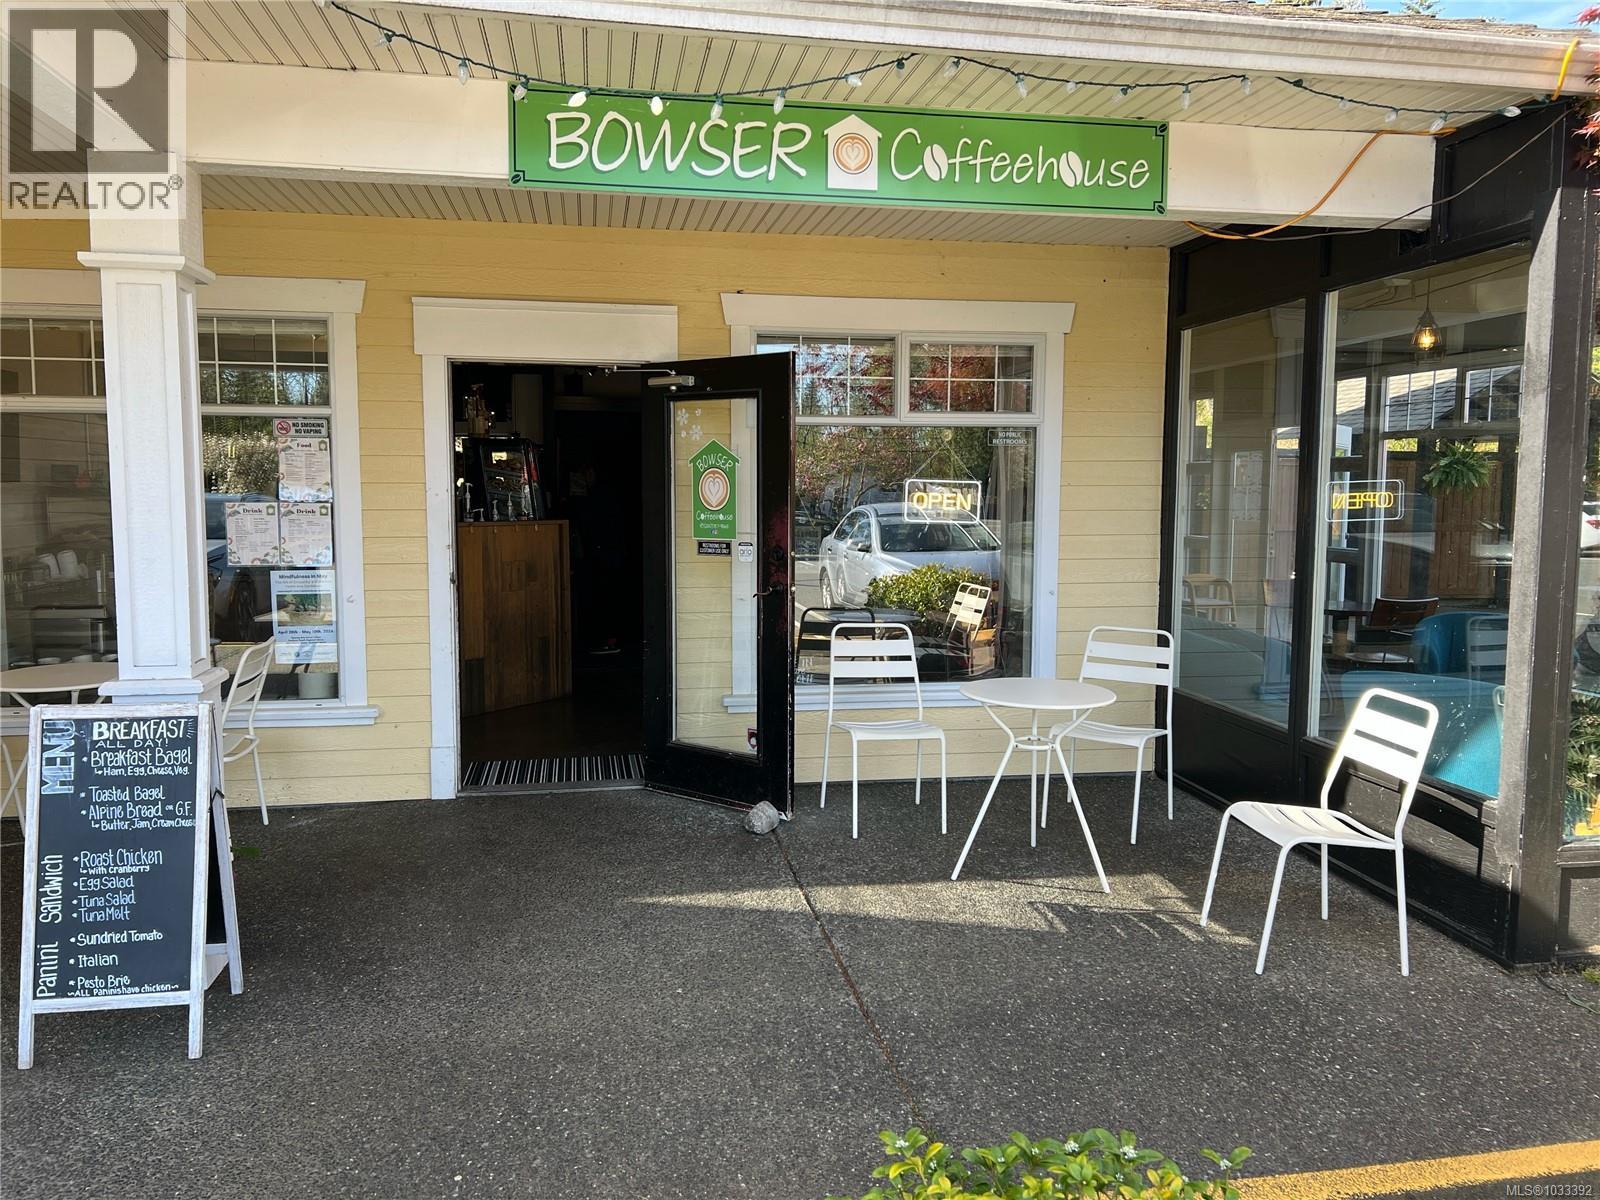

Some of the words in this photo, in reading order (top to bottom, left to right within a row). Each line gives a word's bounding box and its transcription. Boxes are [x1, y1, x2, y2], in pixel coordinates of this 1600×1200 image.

[545, 111, 813, 181] BOWSER
[890, 127, 1150, 190] Coffeehouse
[696, 453, 734, 472] BOWSER
[912, 491, 972, 511] OPEN
[92, 718, 188, 741] BREAKFAST
[95, 740, 126, 748] ALL
[133, 738, 169, 748] DAY!
[41, 719, 76, 795] MENU
[90, 748, 154, 768] Breakfast
[155, 746, 193, 766] Bagel
[88, 785, 131, 802] Toasted
[133, 785, 166, 801] Bagel
[89, 803, 124, 820] Alpine
[126, 800, 164, 819] Bread
[175, 800, 193, 816] G.F.
[152, 818, 175, 828] Cream
[79, 848, 115, 868] Roast
[116, 847, 163, 866] Chicken
[88, 867, 108, 875] with
[108, 865, 151, 874] cranberry
[38, 853, 64, 924] Sandwich
[79, 877, 101, 891] Egg
[101, 875, 135, 890] Salad
[77, 895, 105, 908] Tuna
[105, 889, 137, 906] Salad
[77, 907, 105, 923] Tuna
[105, 905, 132, 921] Melt
[76, 930, 128, 947] Sundried
[128, 929, 164, 942] Tomato
[36, 940, 60, 998] Panini
[77, 953, 120, 968] Italian
[77, 974, 106, 990] Pesto
[107, 974, 132, 989] Brie
[93, 986, 121, 996] Paninis
[121, 985, 140, 995] have
